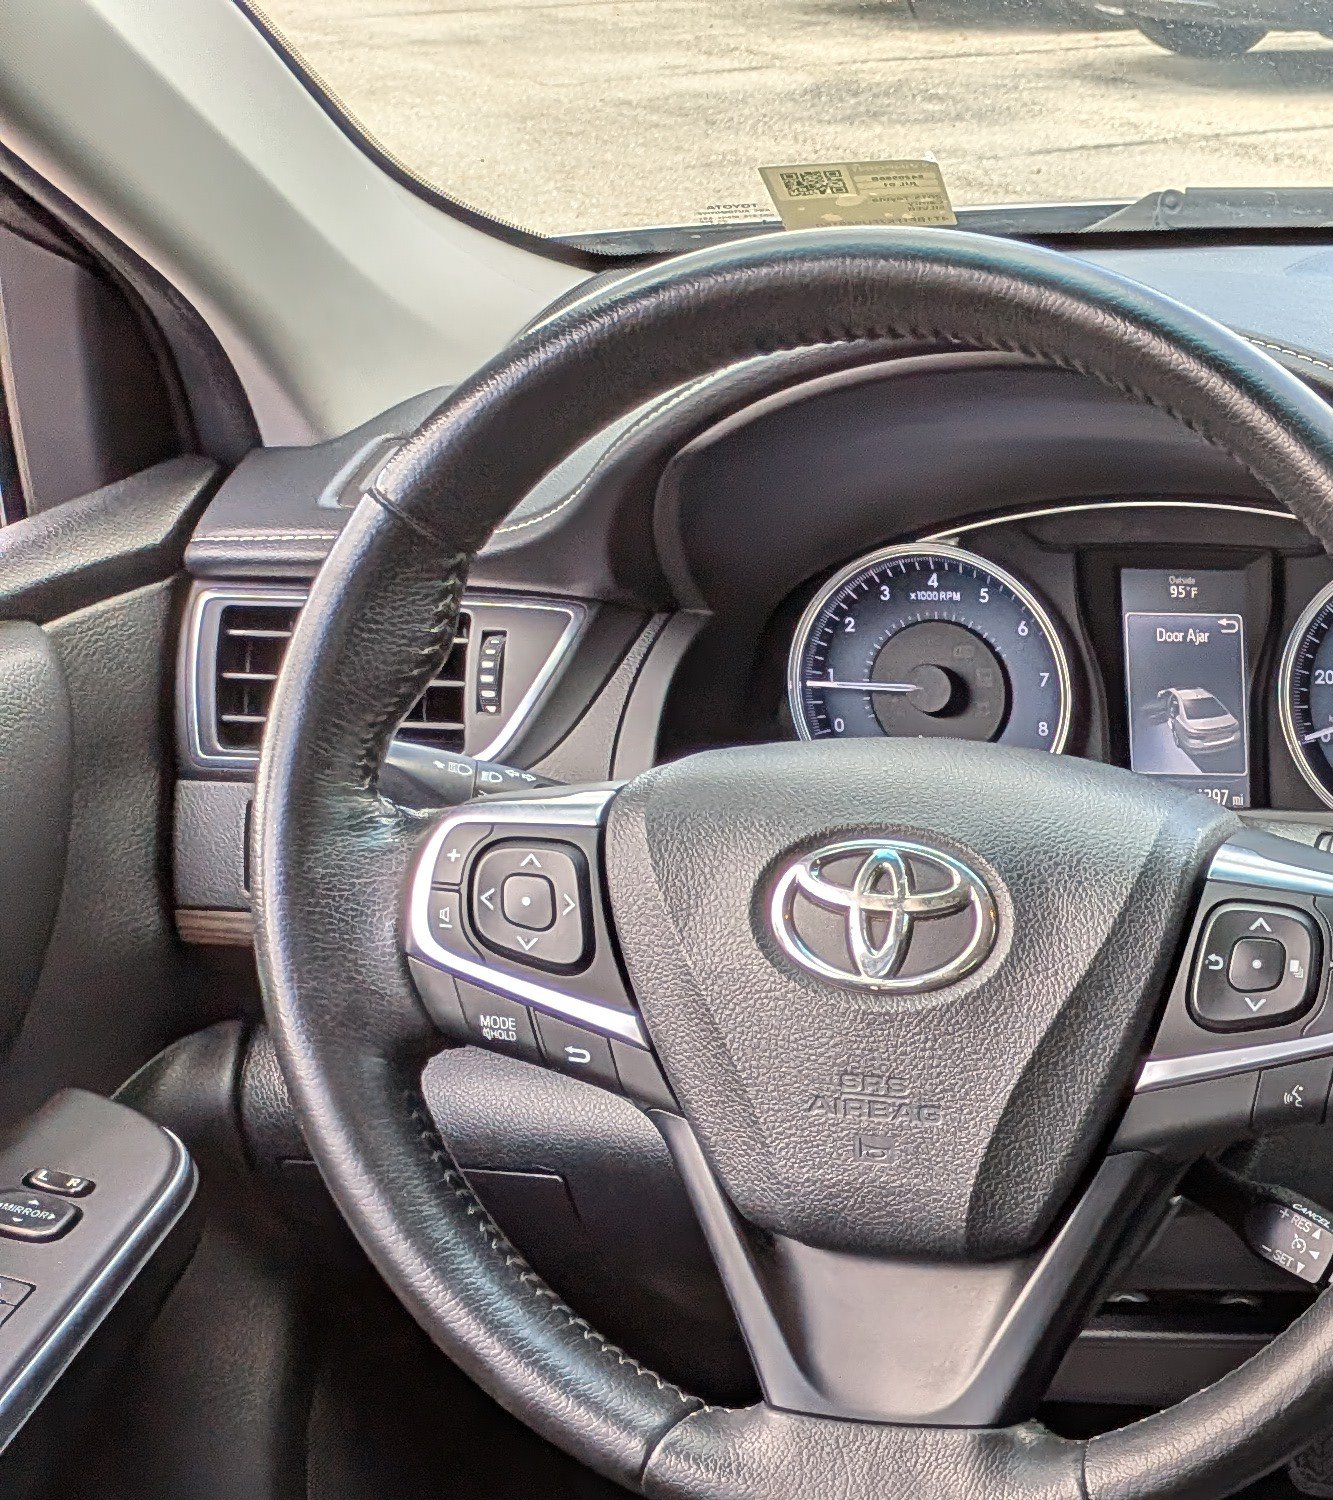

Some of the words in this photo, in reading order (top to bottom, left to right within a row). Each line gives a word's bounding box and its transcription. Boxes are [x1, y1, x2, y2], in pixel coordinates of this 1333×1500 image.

[927, 573, 938, 589] 4
[880, 586, 891, 601] 3
[940, 591, 961, 602] RPM
[978, 588, 989, 603] 5
[844, 617, 856, 633] 2
[1017, 620, 1029, 636] 6
[1156, 628, 1184, 643] Door
[1186, 628, 1210, 646] Ajar
[1039, 672, 1050, 687] 7
[833, 719, 845, 733] 0
[1038, 721, 1049, 736] 8
[479, 1014, 517, 1031] MODE
[489, 1029, 518, 1042] HOLD
[37, 1168, 48, 1181] L
[66, 1176, 81, 1188] R
[2, 1202, 49, 1221] MIRROR
[1292, 1203, 1332, 1229] CANCEL
